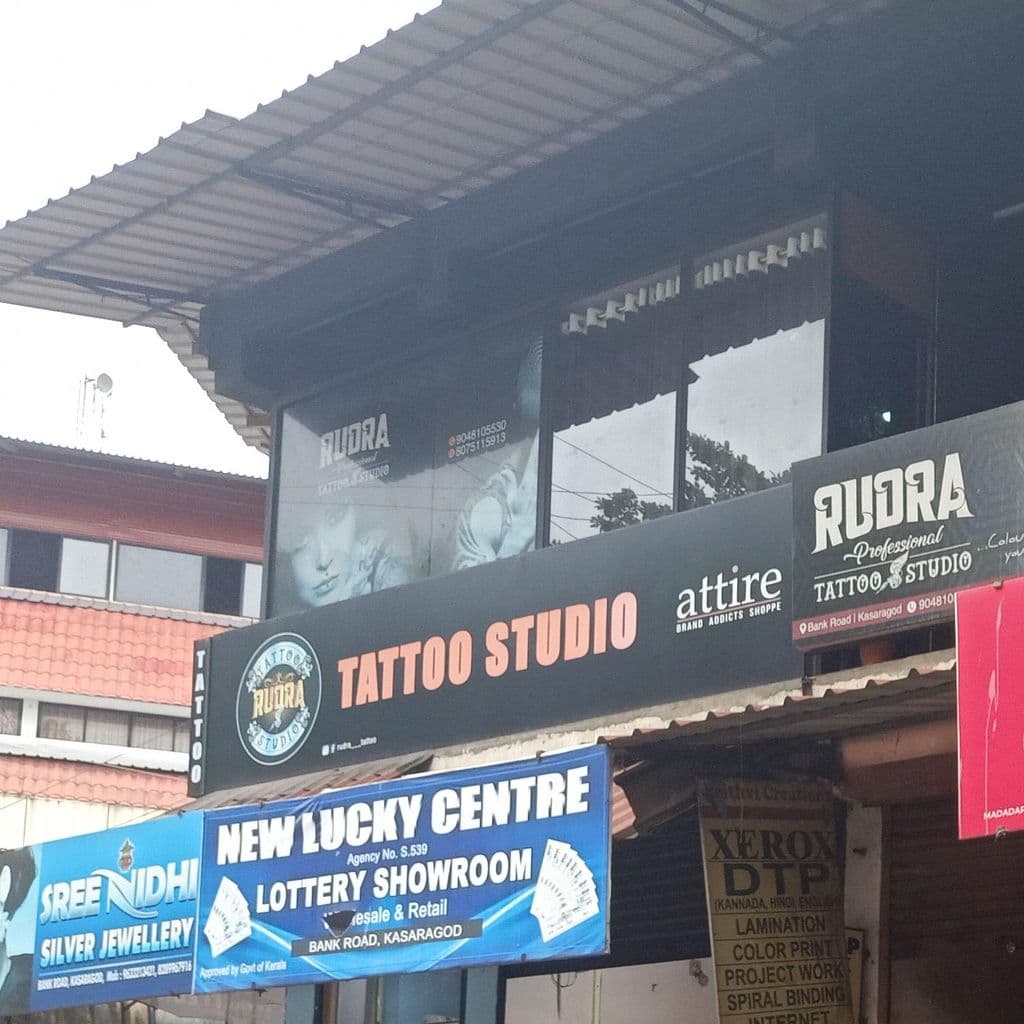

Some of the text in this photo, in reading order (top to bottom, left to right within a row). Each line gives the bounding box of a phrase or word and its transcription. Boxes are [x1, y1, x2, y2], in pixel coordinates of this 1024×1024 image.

[320, 413, 391, 468] RUDRA
[811, 452, 974, 554] RUDRA
[843, 525, 944, 564] Professional
[676, 565, 783, 619] attire
[814, 550, 972, 602] TATTOO STUDIO
[676, 602, 782, 634] BRAND ADDICTS SHOPPE
[807, 620, 829, 633] Bank
[830, 614, 852, 628] Road
[858, 604, 902, 622] Kasaragod
[919, 592, 955, 610] 904810
[338, 591, 638, 709] TATTOO STUDIO
[191, 650, 205, 784] TATTOO
[253, 679, 306, 719] RUDRA
[257, 724, 300, 750] STUDIO
[217, 765, 591, 865] NEW LUCKY CENTRE
[347, 843, 428, 867] Agency No. S.539
[710, 829, 834, 860] XEROX
[40, 857, 199, 926] SREENIDHI
[256, 848, 533, 914] LOTTERY SHOWROOM
[723, 862, 830, 896] DTP
[394, 904, 405, 920] &
[408, 898, 448, 920] Retail
[736, 915, 826, 936] LAMINATION
[40, 917, 195, 968] SILVER JEWELLERY
[309, 924, 463, 953] BANK ROAD, KASARAGOD
[733, 939, 834, 962] COLOR PRINT
[725, 962, 844, 987] PROJECT WORK
[727, 985, 846, 1012] SPIRAL BINDING
